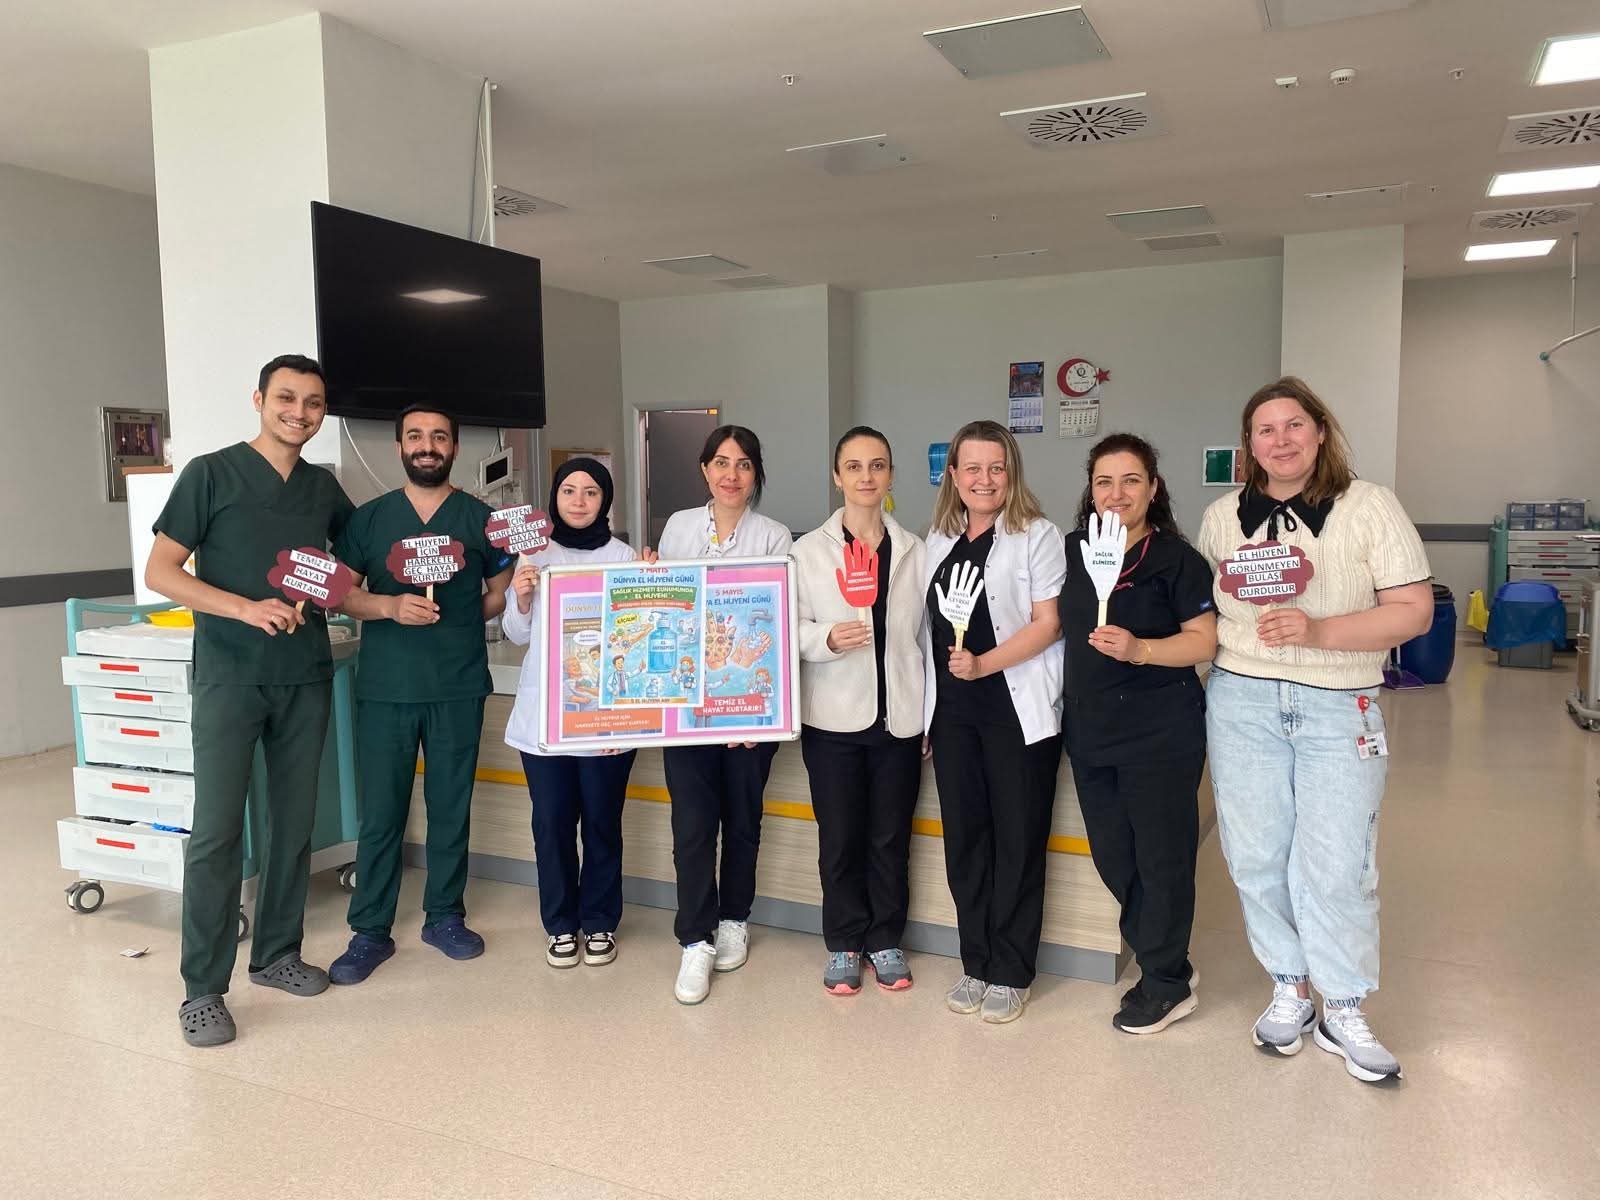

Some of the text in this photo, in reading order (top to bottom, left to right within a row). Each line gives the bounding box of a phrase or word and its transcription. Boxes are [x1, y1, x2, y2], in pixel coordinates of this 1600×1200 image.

[511, 531, 537, 543] HAYAT
[403, 541, 413, 549] EL
[512, 537, 545, 552] KURTAR
[1239, 546, 1287, 560] EL HİJYENİ
[296, 552, 334, 571] TEMİZ EL
[407, 555, 452, 566] HAREKETE
[405, 564, 456, 575] GEÇ HAYAT
[1229, 559, 1299, 574] GÖRÜNMEYEN
[296, 567, 325, 582] HAYAT
[412, 572, 449, 583] KURTAR
[613, 575, 695, 584] DÜNYA EL HİJYENİ GÜNÜ
[722, 588, 744, 596] MAYIS
[1239, 584, 1296, 597] DURDURUR
[723, 596, 750, 605] HİJYENİ
[751, 595, 771, 604] GÜNÜ
[714, 698, 736, 706] TEMİZ
[726, 705, 762, 713] KURTARIR!
